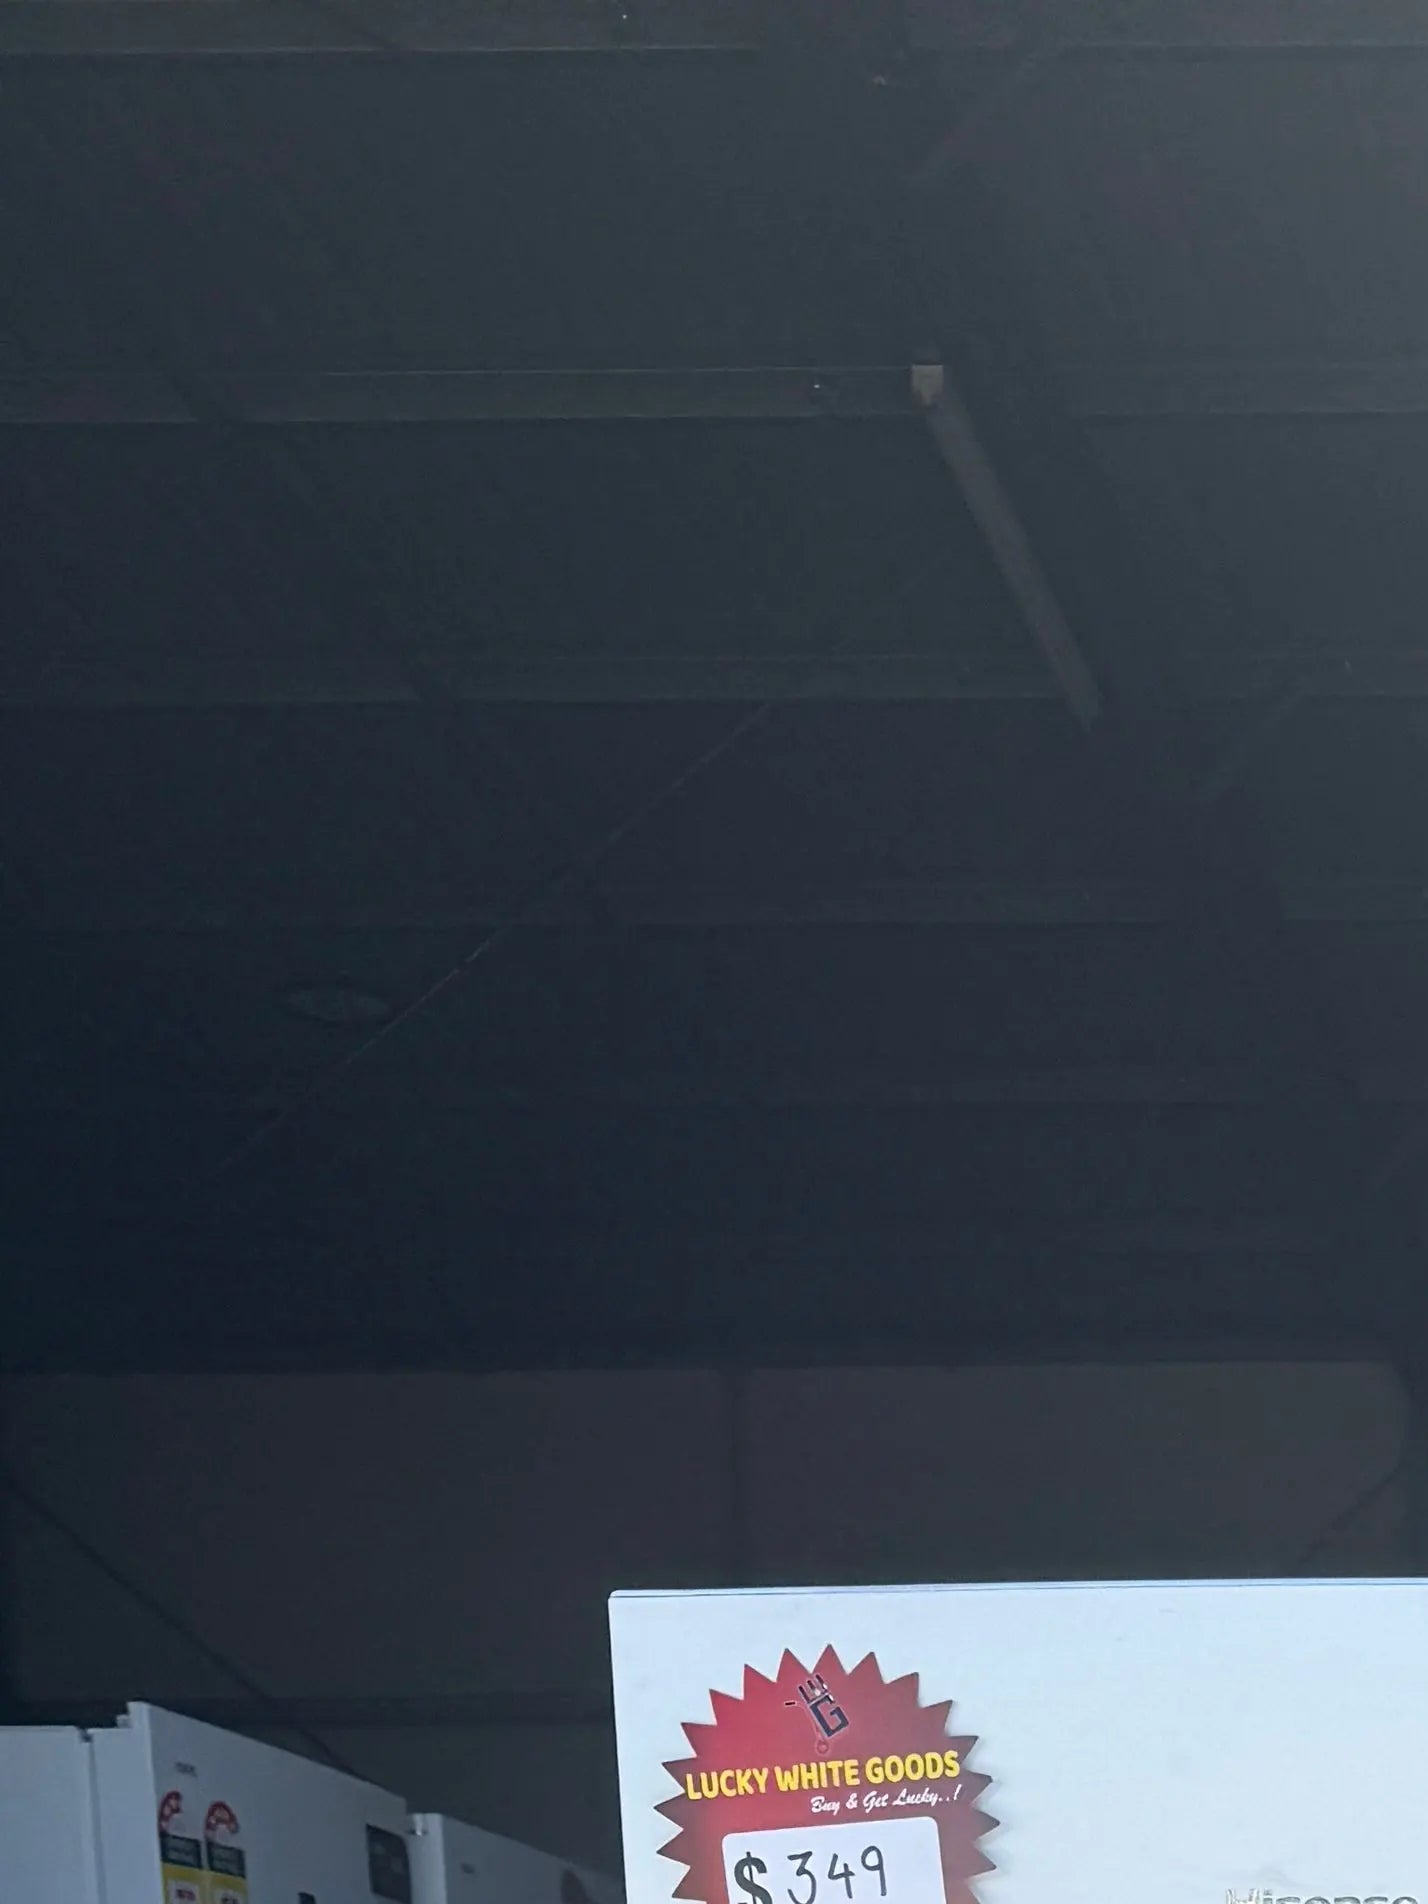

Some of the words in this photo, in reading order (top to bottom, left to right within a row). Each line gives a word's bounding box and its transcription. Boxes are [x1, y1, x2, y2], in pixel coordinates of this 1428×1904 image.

[685, 1767, 769, 1801] LUCKY
[774, 1758, 861, 1793] WHITE
[864, 1749, 961, 1785] GOODS
[810, 1795, 841, 1816] Buy
[846, 1793, 858, 1811] &
[863, 1791, 889, 1815] Get
